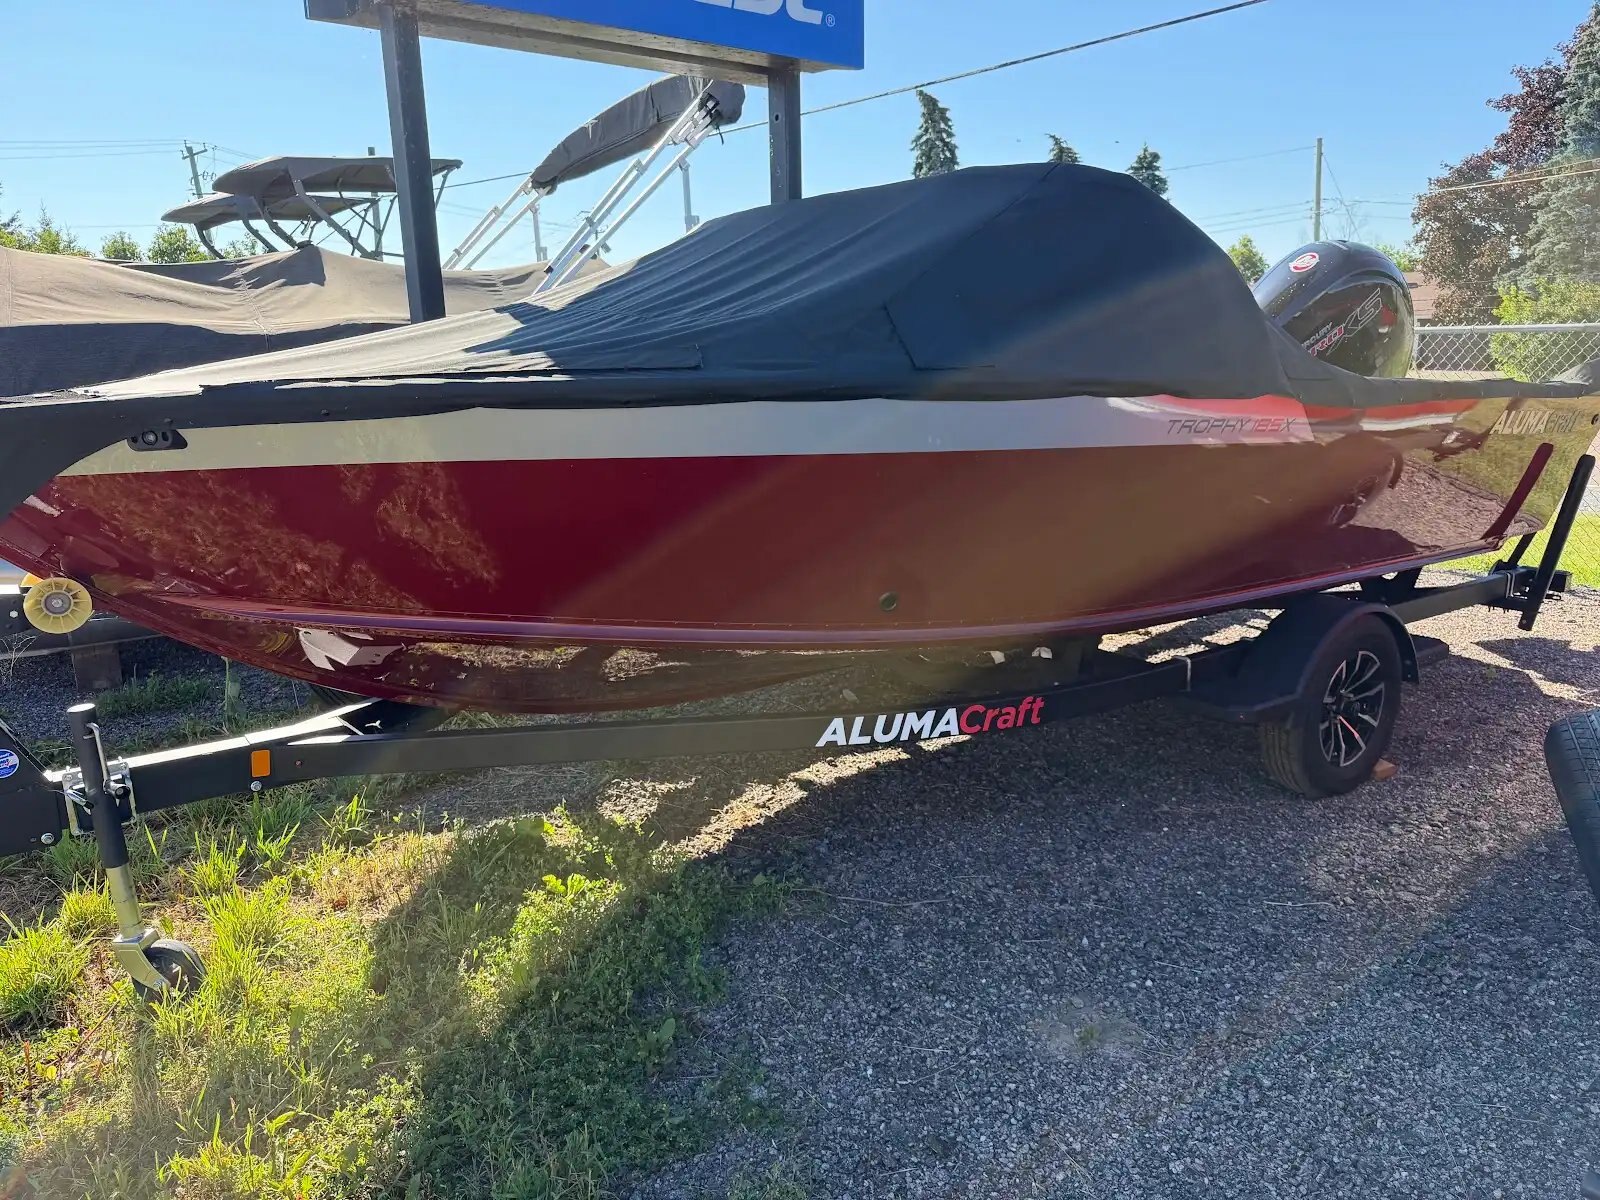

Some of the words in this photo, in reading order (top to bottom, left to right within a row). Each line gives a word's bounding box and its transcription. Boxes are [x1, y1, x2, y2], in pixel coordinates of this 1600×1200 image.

[1301, 321, 1333, 350] RCURY
[1167, 418, 1251, 434] TROPHY
[1489, 408, 1582, 435] ALUMACraft
[815, 696, 1045, 747] ALUMACraft
